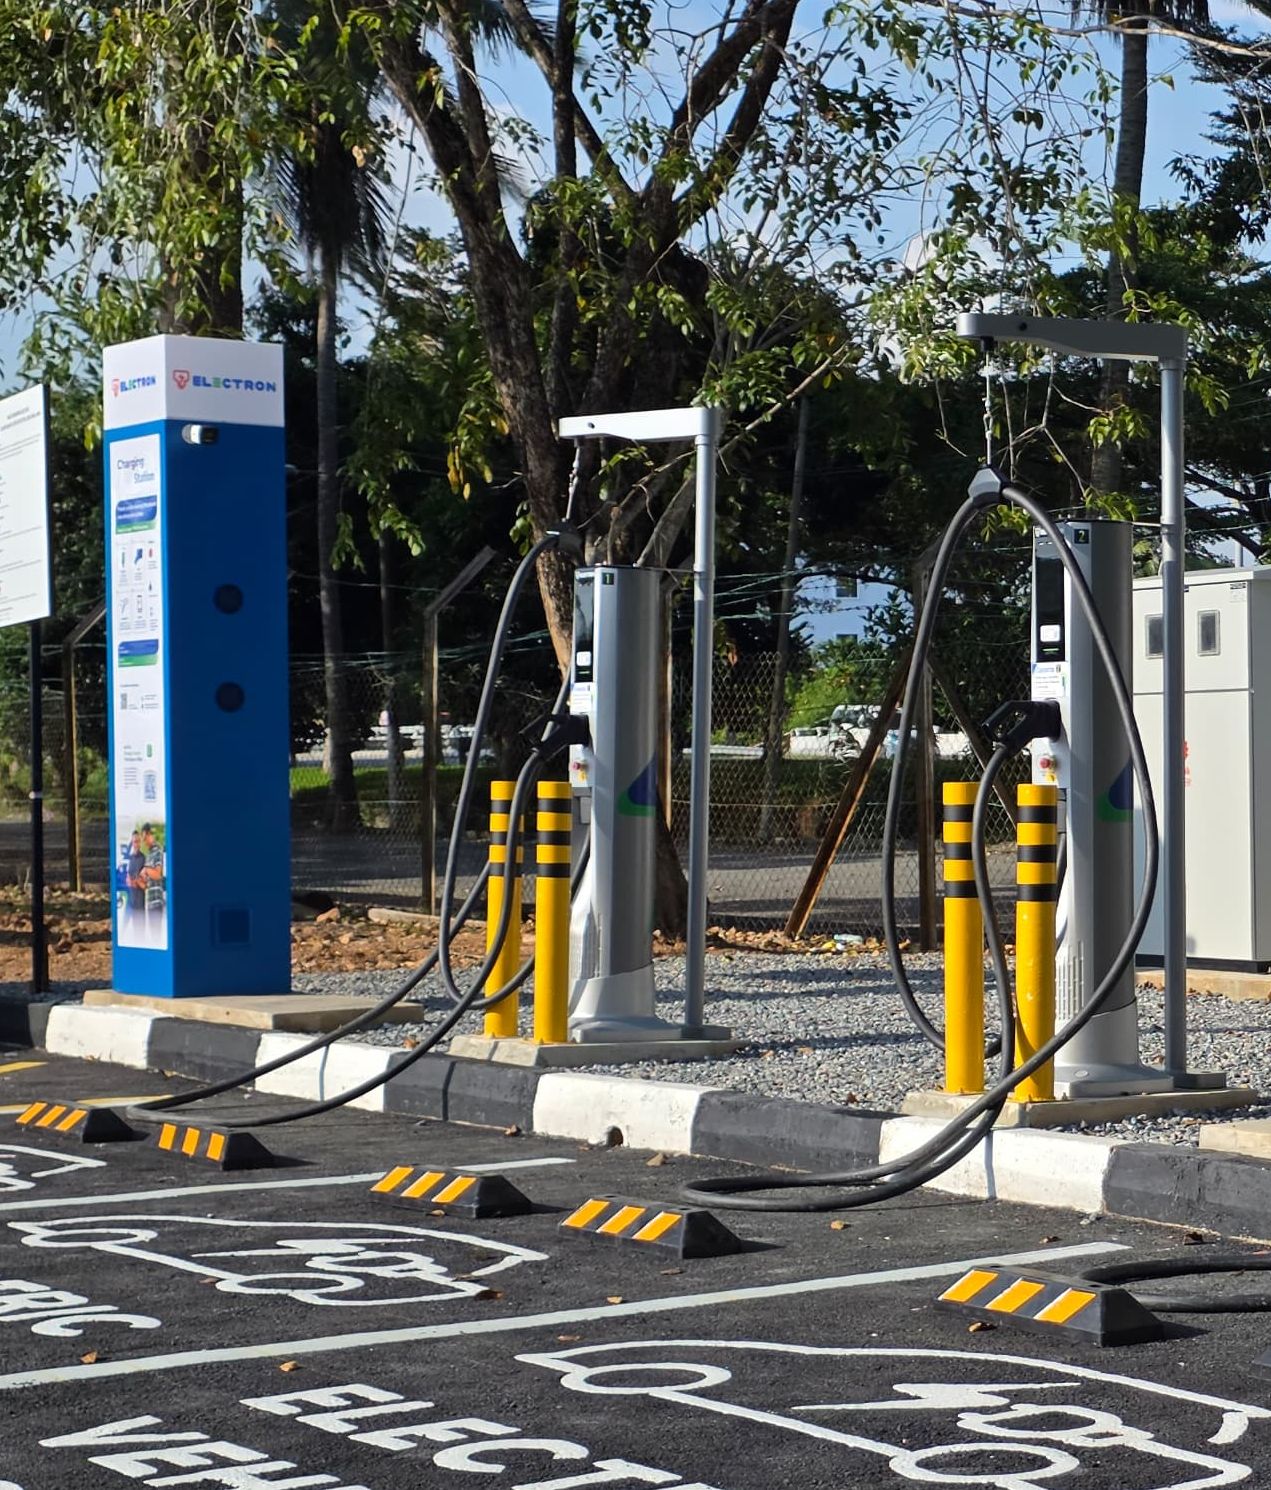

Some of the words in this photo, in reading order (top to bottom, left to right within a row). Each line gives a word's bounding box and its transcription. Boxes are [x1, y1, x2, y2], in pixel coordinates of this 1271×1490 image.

[120, 375, 156, 392] ELECTRON
[192, 375, 276, 392] ELECTRON
[39, 1415, 370, 1490] VEH
[239, 1384, 721, 1490] ELECT
